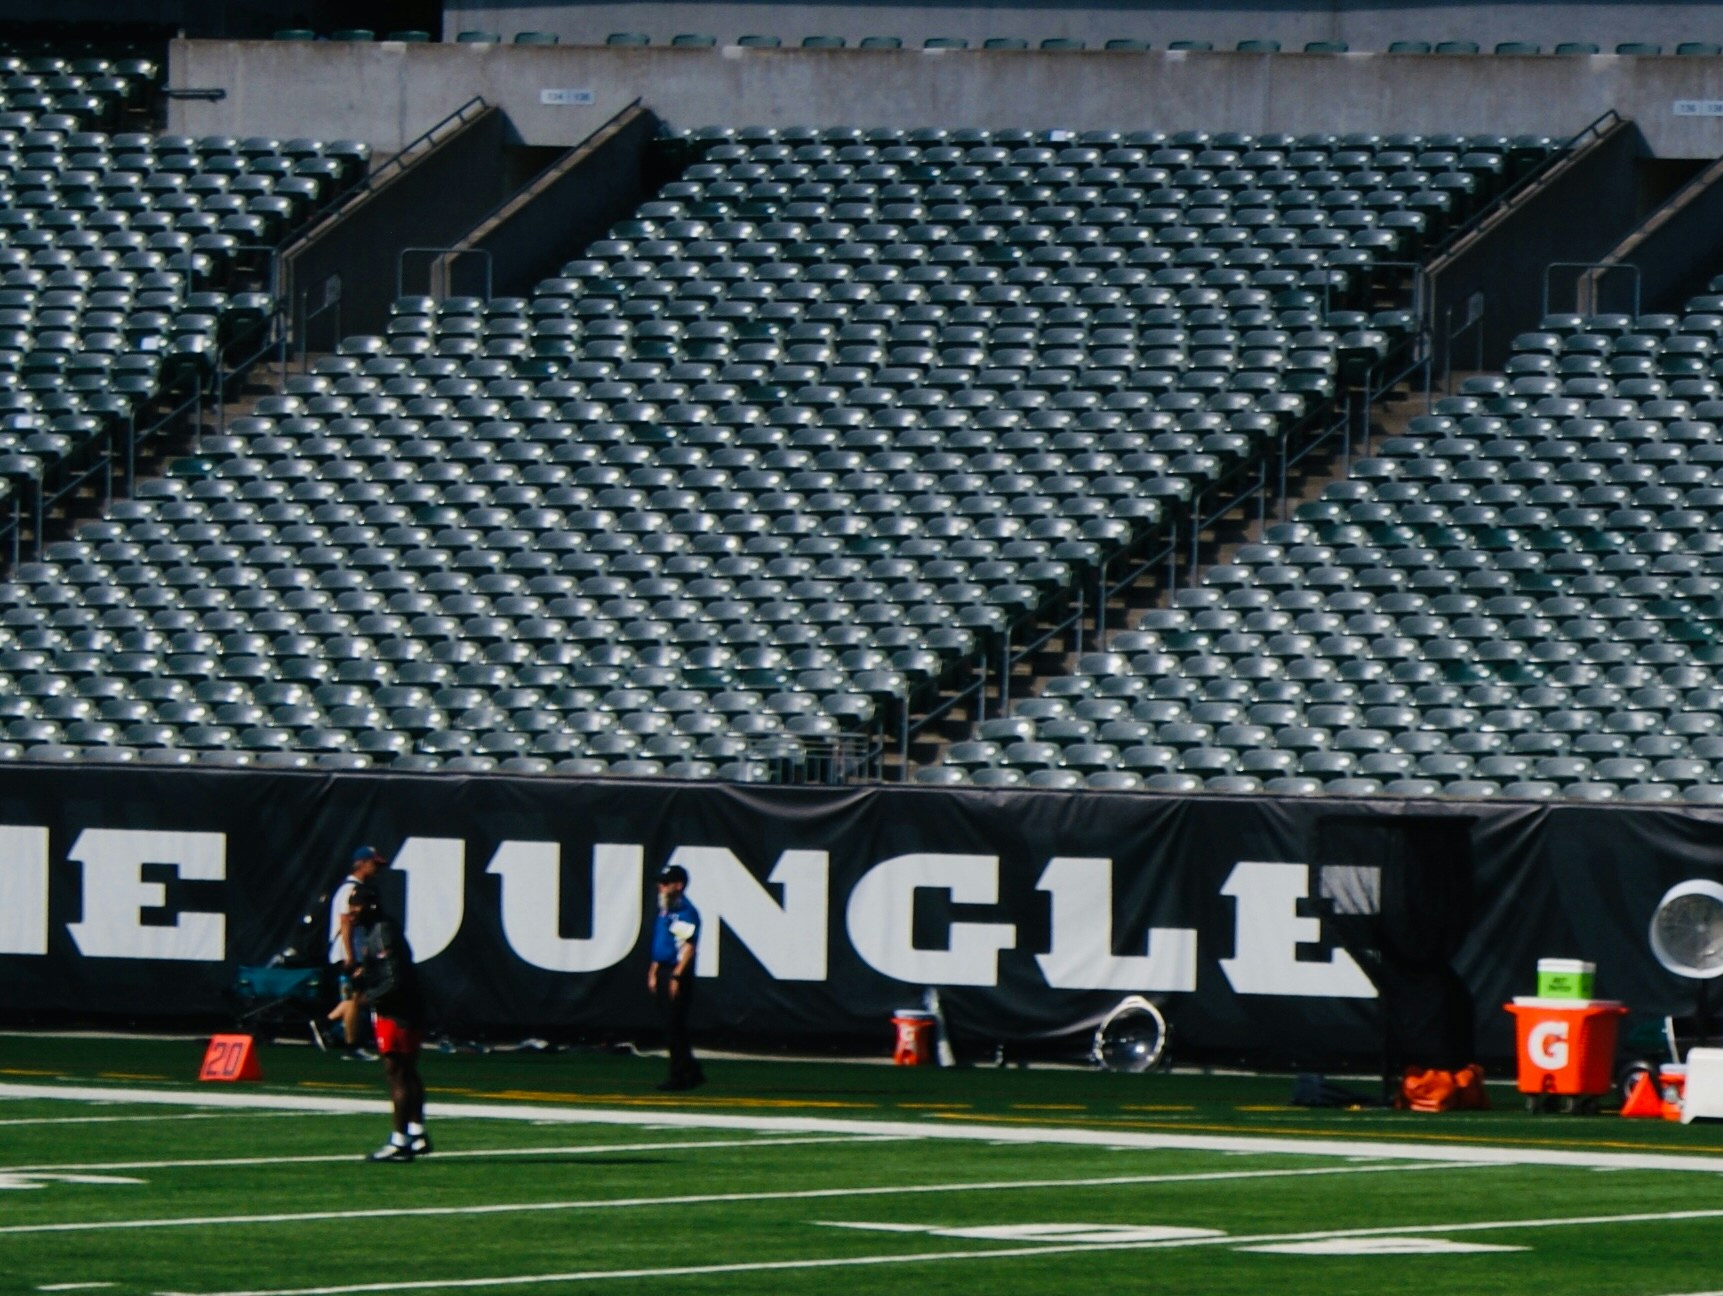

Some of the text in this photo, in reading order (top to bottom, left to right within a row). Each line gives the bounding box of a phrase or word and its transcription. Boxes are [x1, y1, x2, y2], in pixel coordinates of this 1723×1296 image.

[390, 836, 1381, 998] JUNGLE
[205, 1042, 243, 1076] 20
[1527, 1021, 1569, 1071] G
